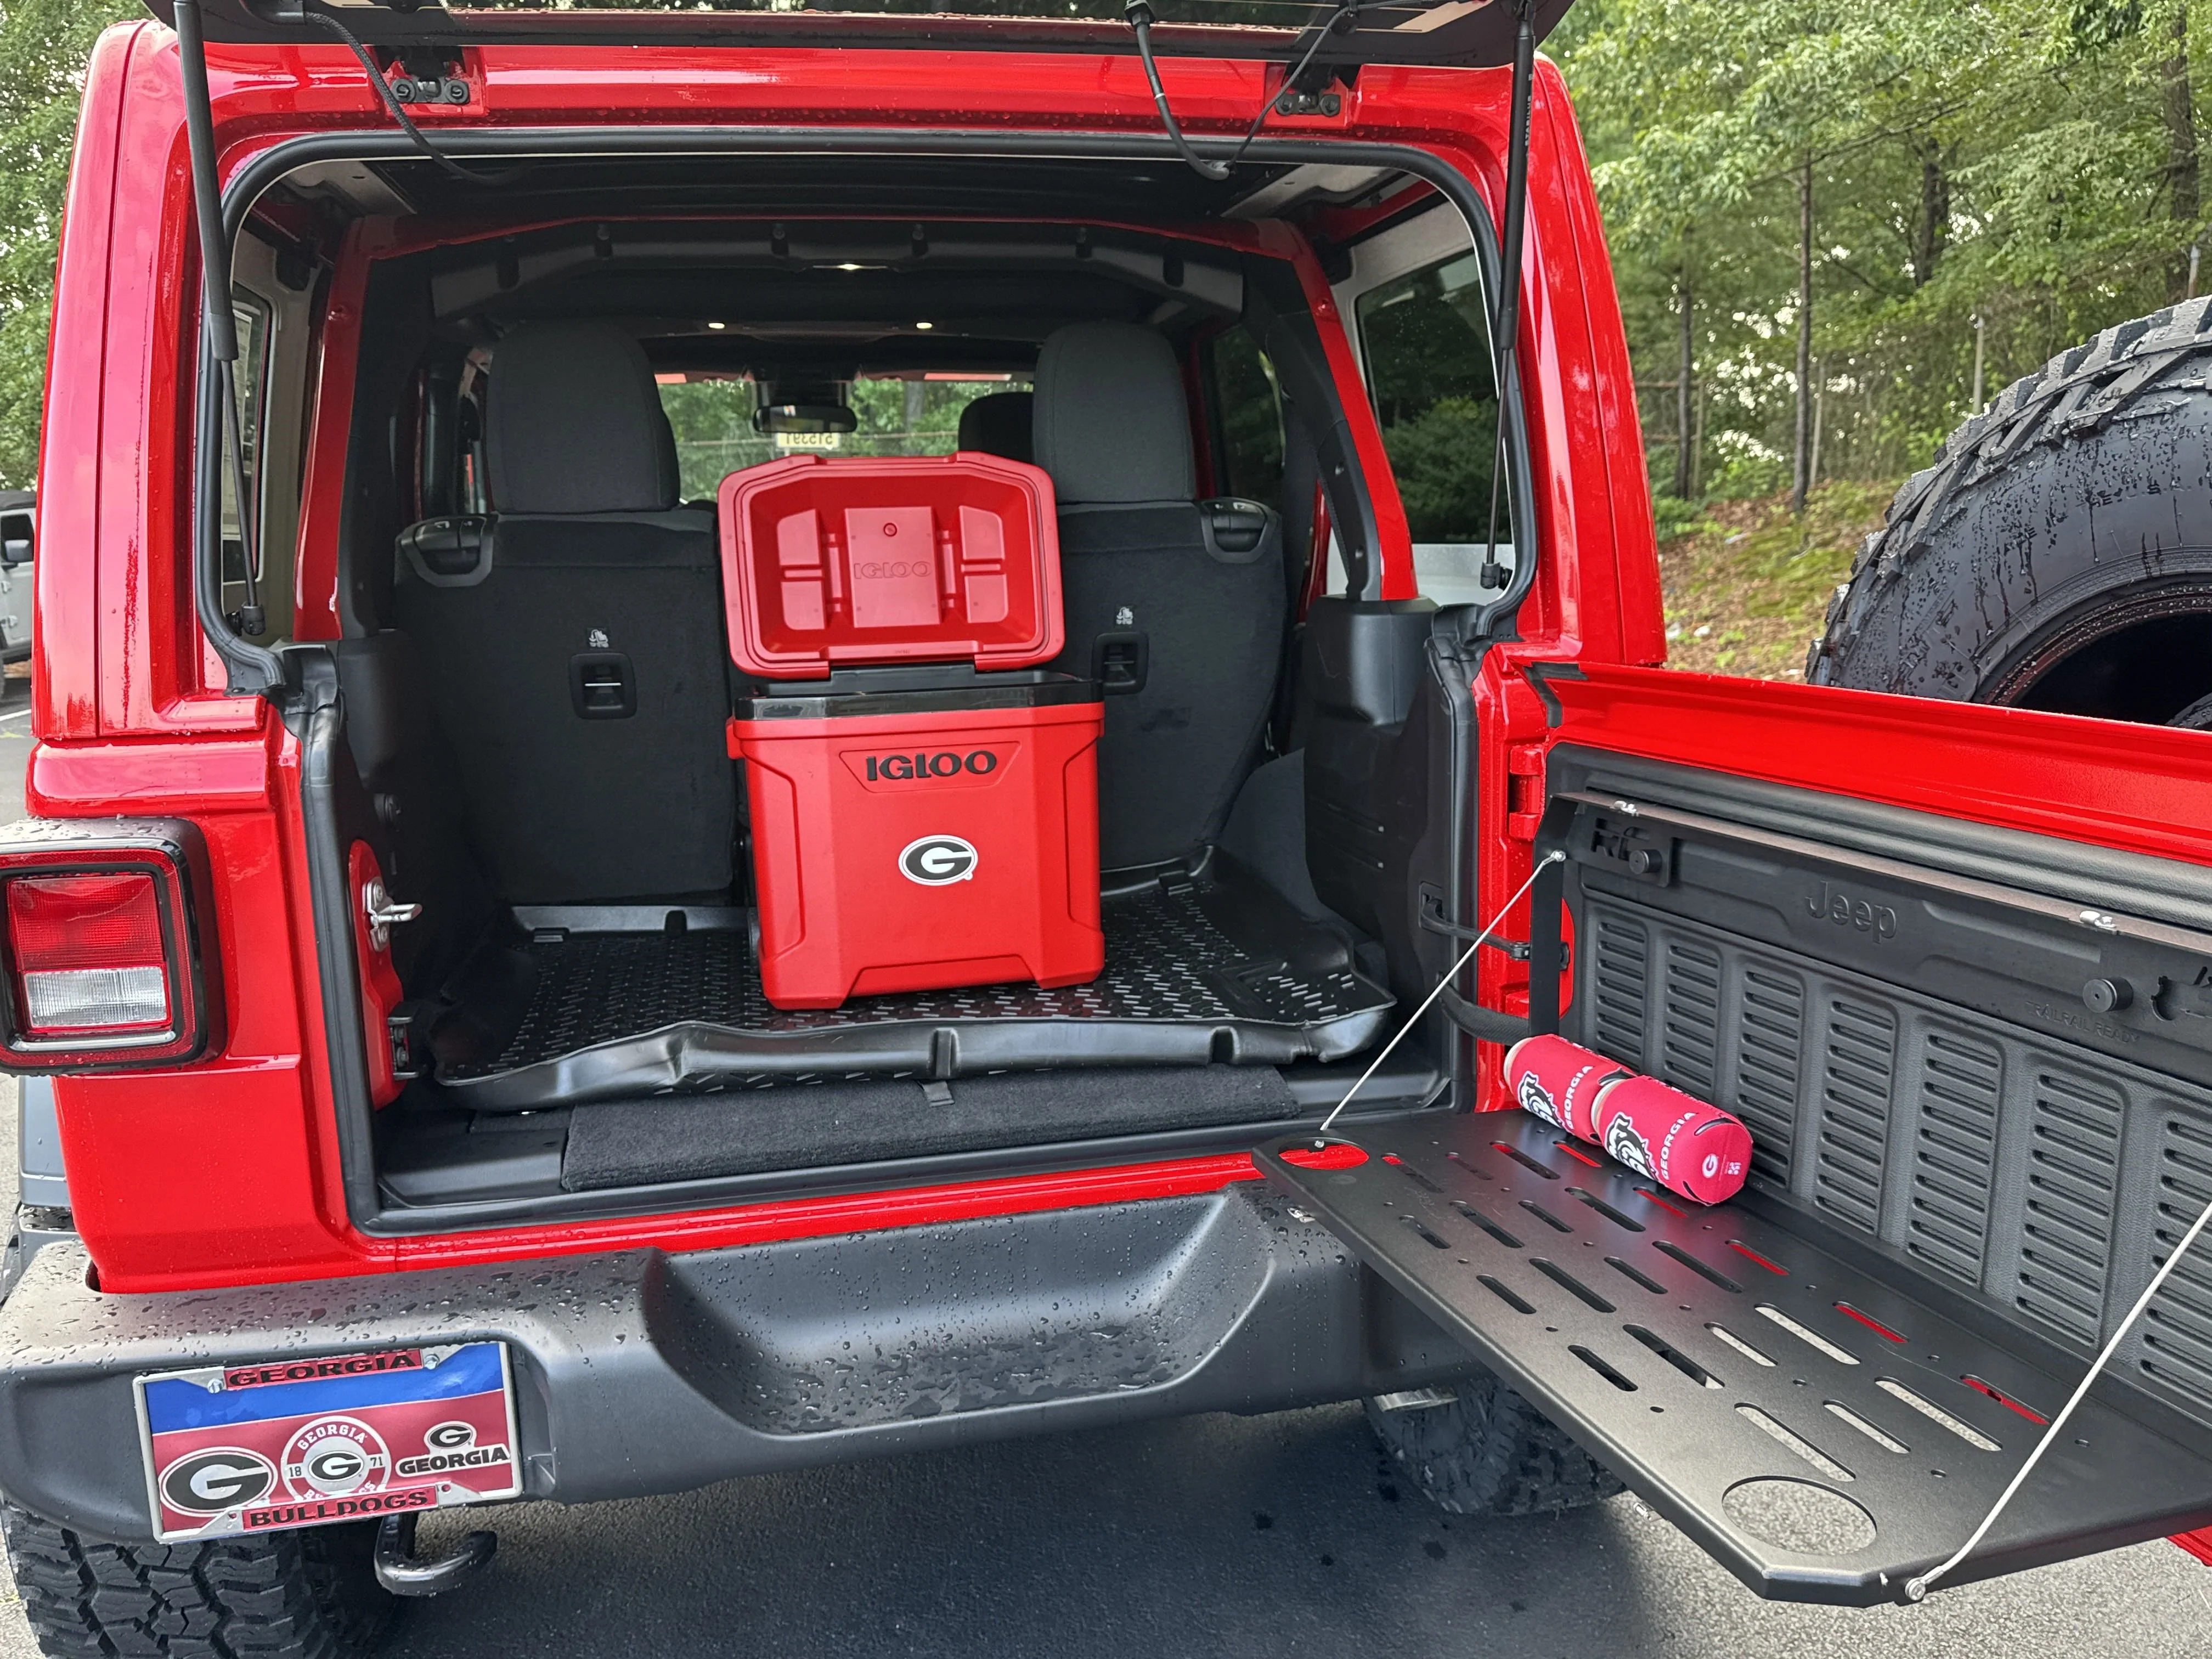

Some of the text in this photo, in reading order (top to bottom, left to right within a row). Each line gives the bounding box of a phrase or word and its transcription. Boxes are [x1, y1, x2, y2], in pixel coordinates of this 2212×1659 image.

[853, 561, 932, 579] IGLOO
[866, 750, 997, 781] IGLOO
[905, 840, 973, 881] G
[1804, 880, 1898, 944] Jeep
[1563, 1065, 1594, 1130] GEORGIA
[1659, 1111, 1700, 1181] GEORGIA
[228, 1352, 416, 1387] GEORGIA
[296, 1424, 366, 1451] GEORGIA
[430, 1426, 472, 1449] G
[288, 1465, 302, 1478] 18
[311, 1453, 363, 1480] G
[370, 1455, 383, 1466] 71
[399, 1446, 510, 1476] GEORGIA
[165, 1449, 270, 1510] G
[249, 1491, 430, 1528] BULLDOGS
